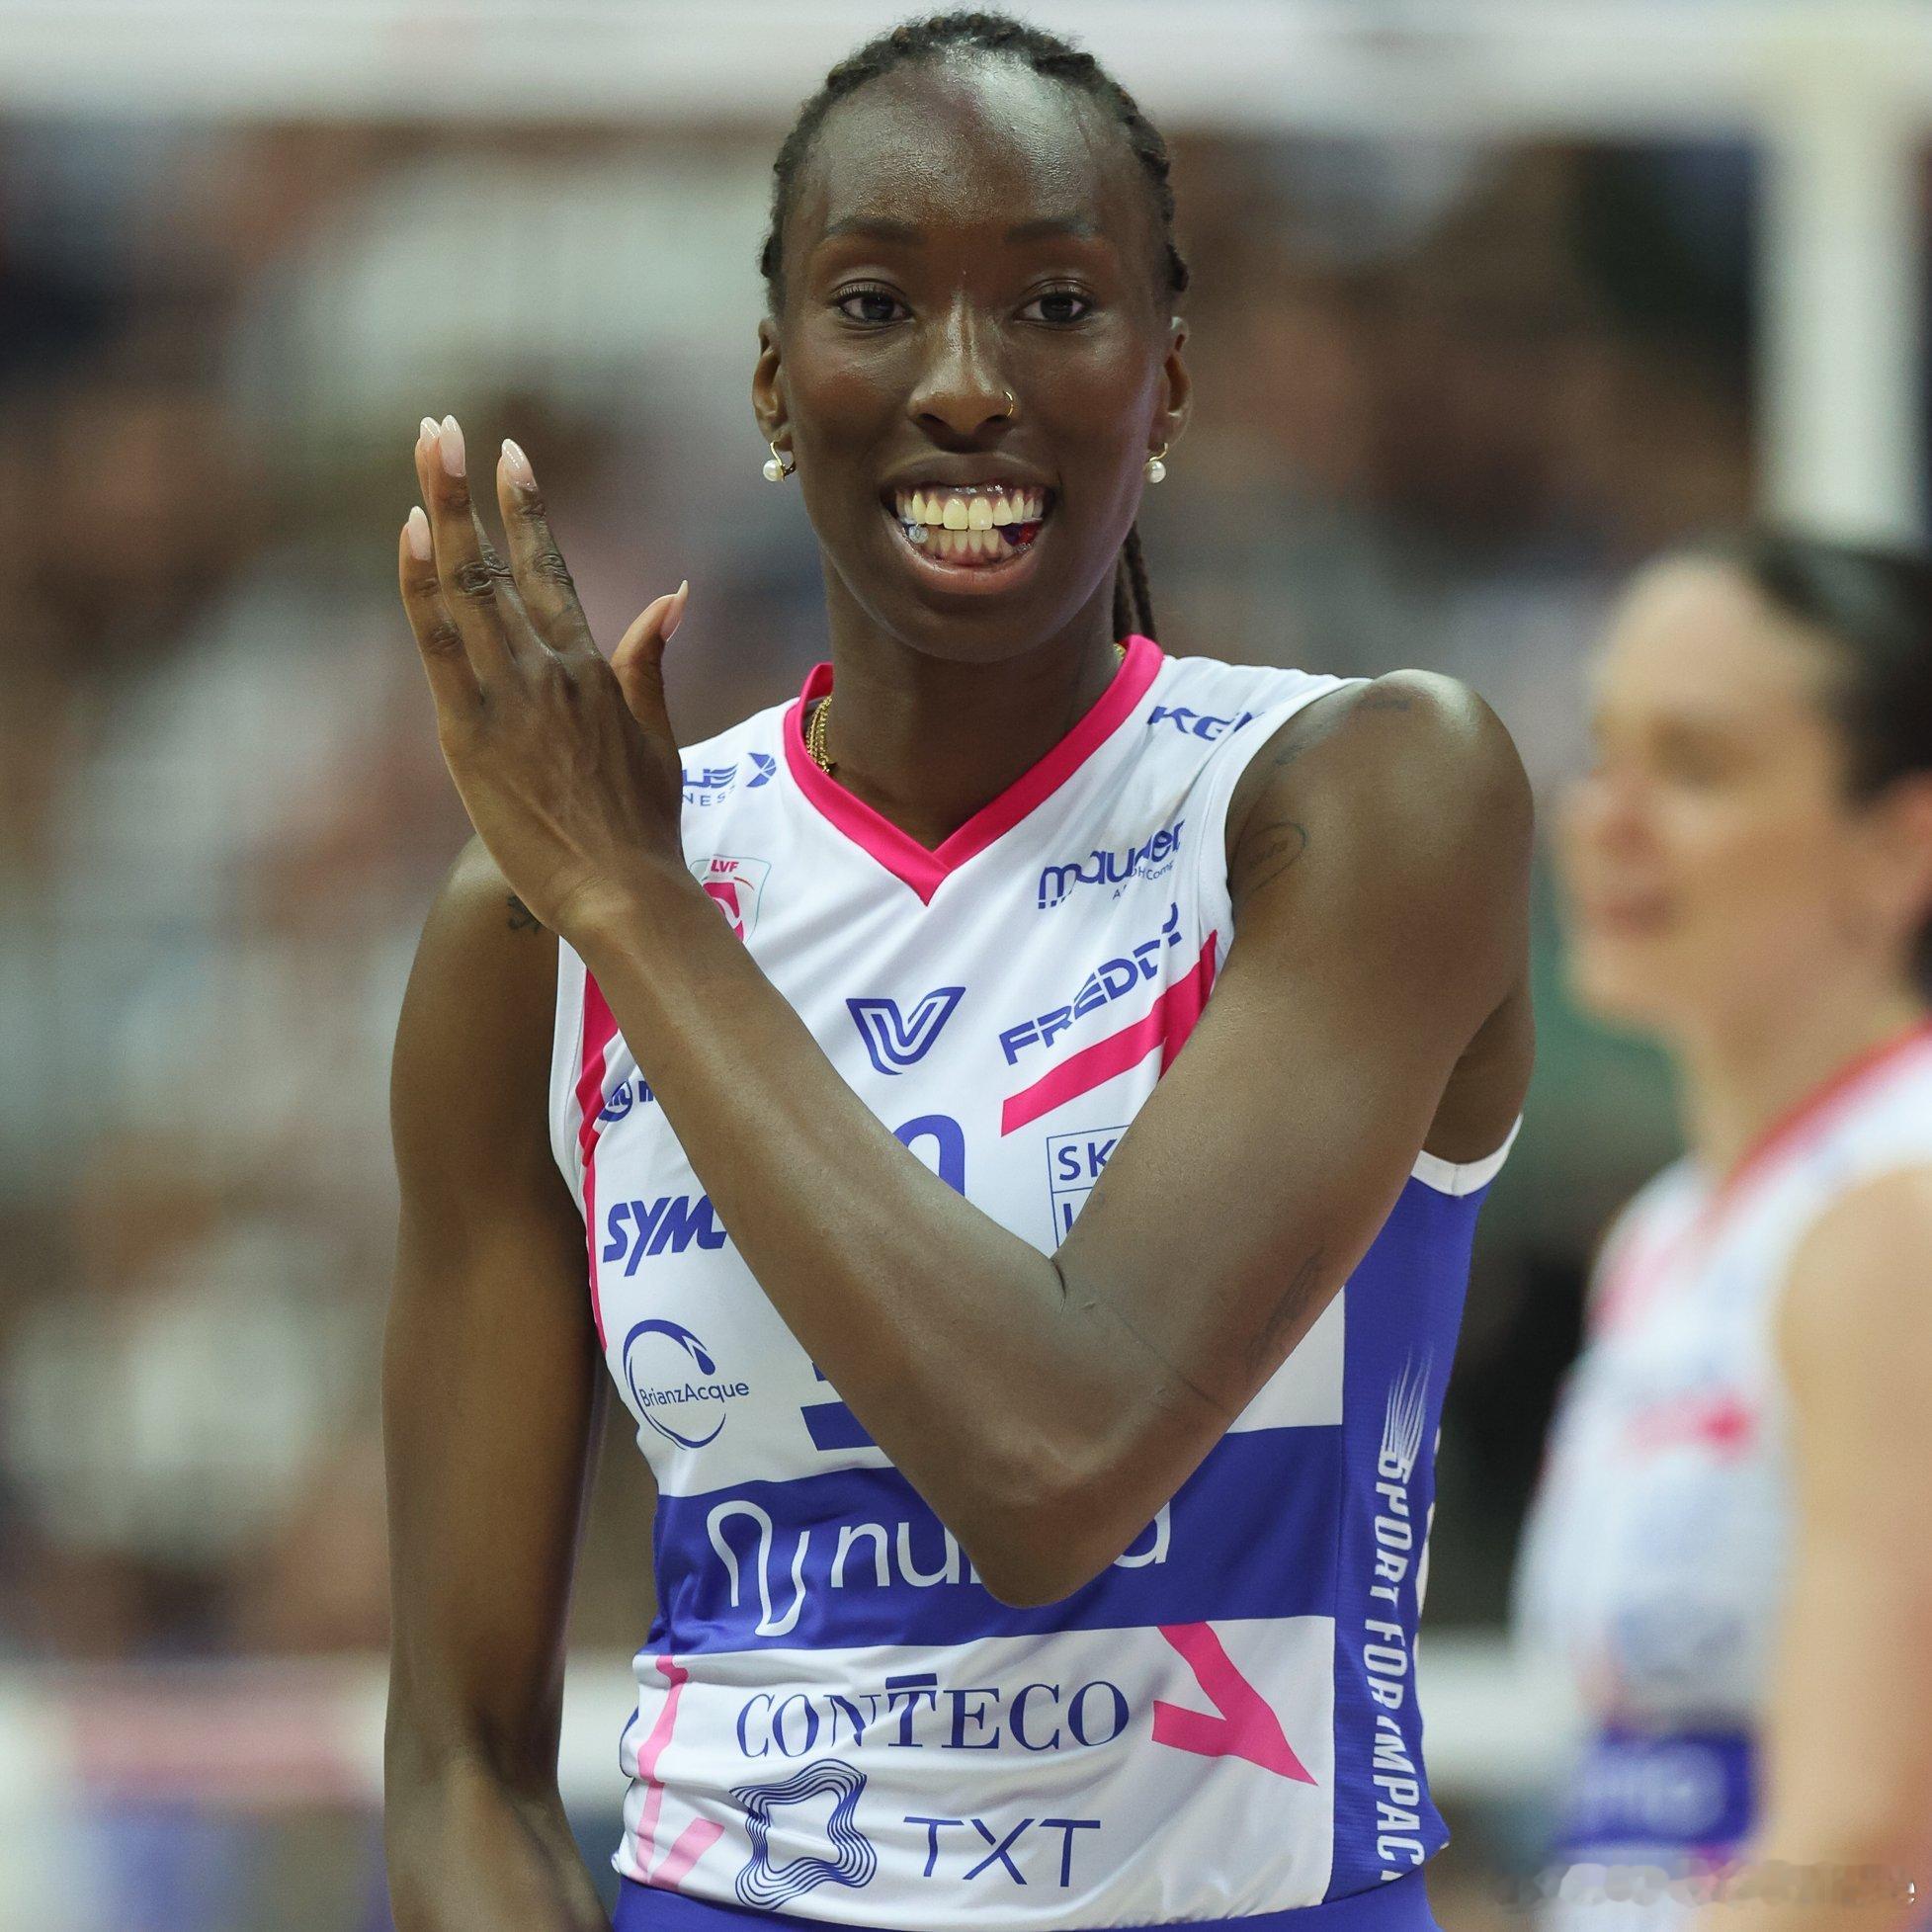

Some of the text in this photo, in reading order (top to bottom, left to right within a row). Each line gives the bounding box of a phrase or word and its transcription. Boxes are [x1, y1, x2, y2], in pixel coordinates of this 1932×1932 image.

[711, 859, 739, 873] LVF
[638, 1382, 751, 1408] BrianzAcque
[736, 1672, 1131, 1758] CONTECO
[902, 1815, 1102, 1888] TXT
